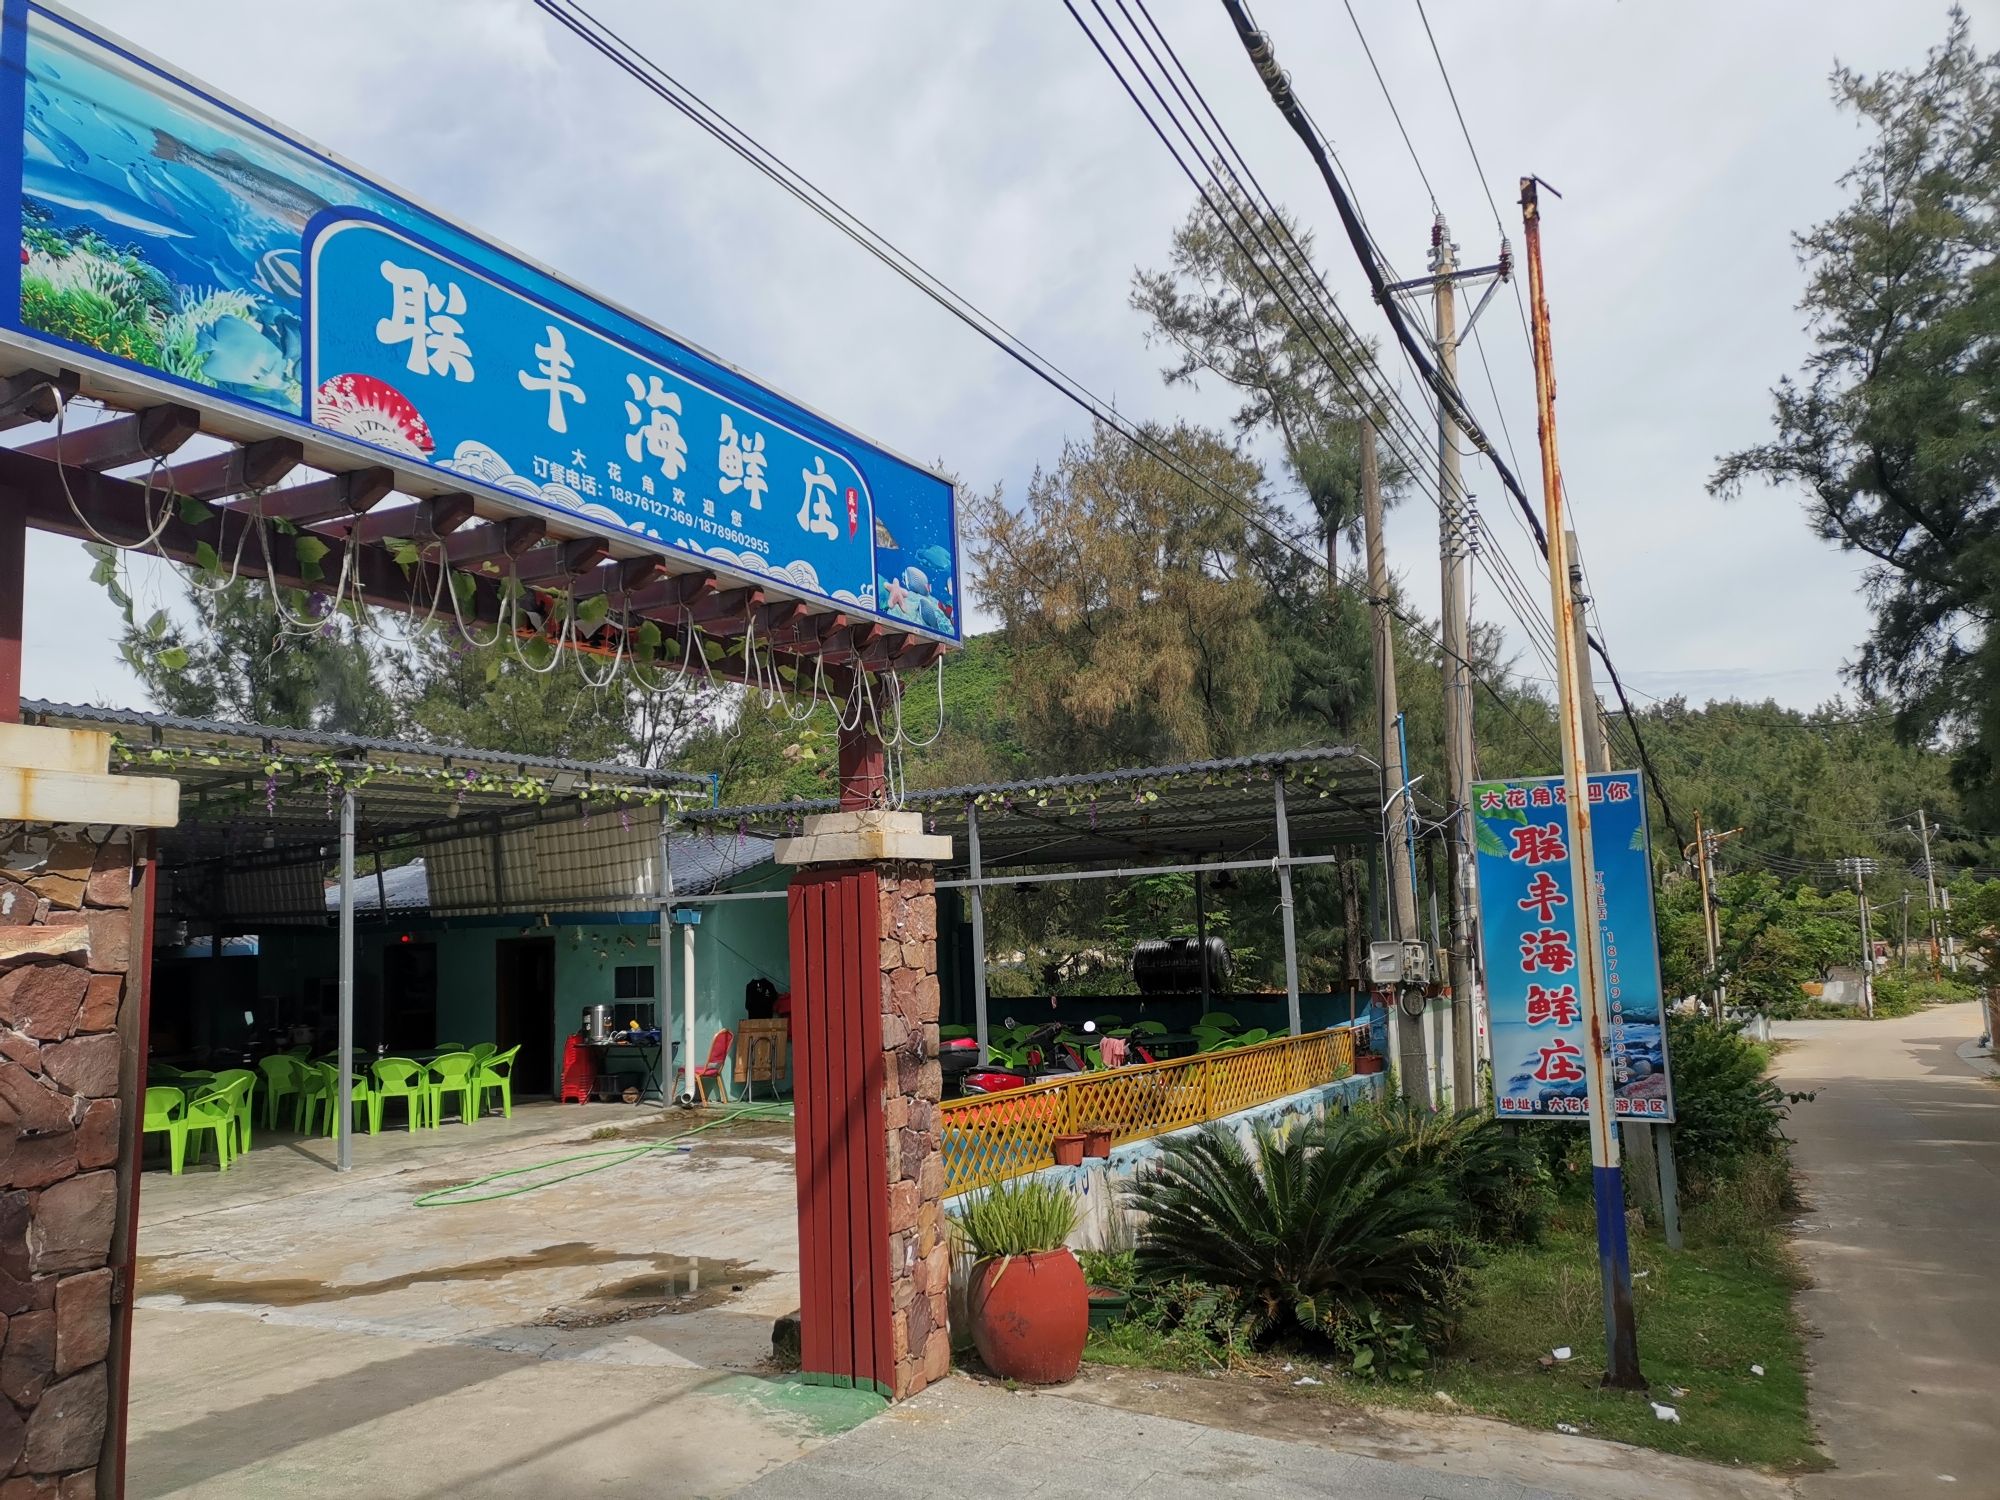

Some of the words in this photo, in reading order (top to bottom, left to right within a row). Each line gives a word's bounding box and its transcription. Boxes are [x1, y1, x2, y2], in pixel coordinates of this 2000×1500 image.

[376, 260, 840, 542] 联丰海鲜庄
[571, 448, 743, 528] 大花角欢迎您
[1509, 822, 1585, 1085] 联丰海鲜庄
[1606, 931, 1629, 1083] 18789602955
